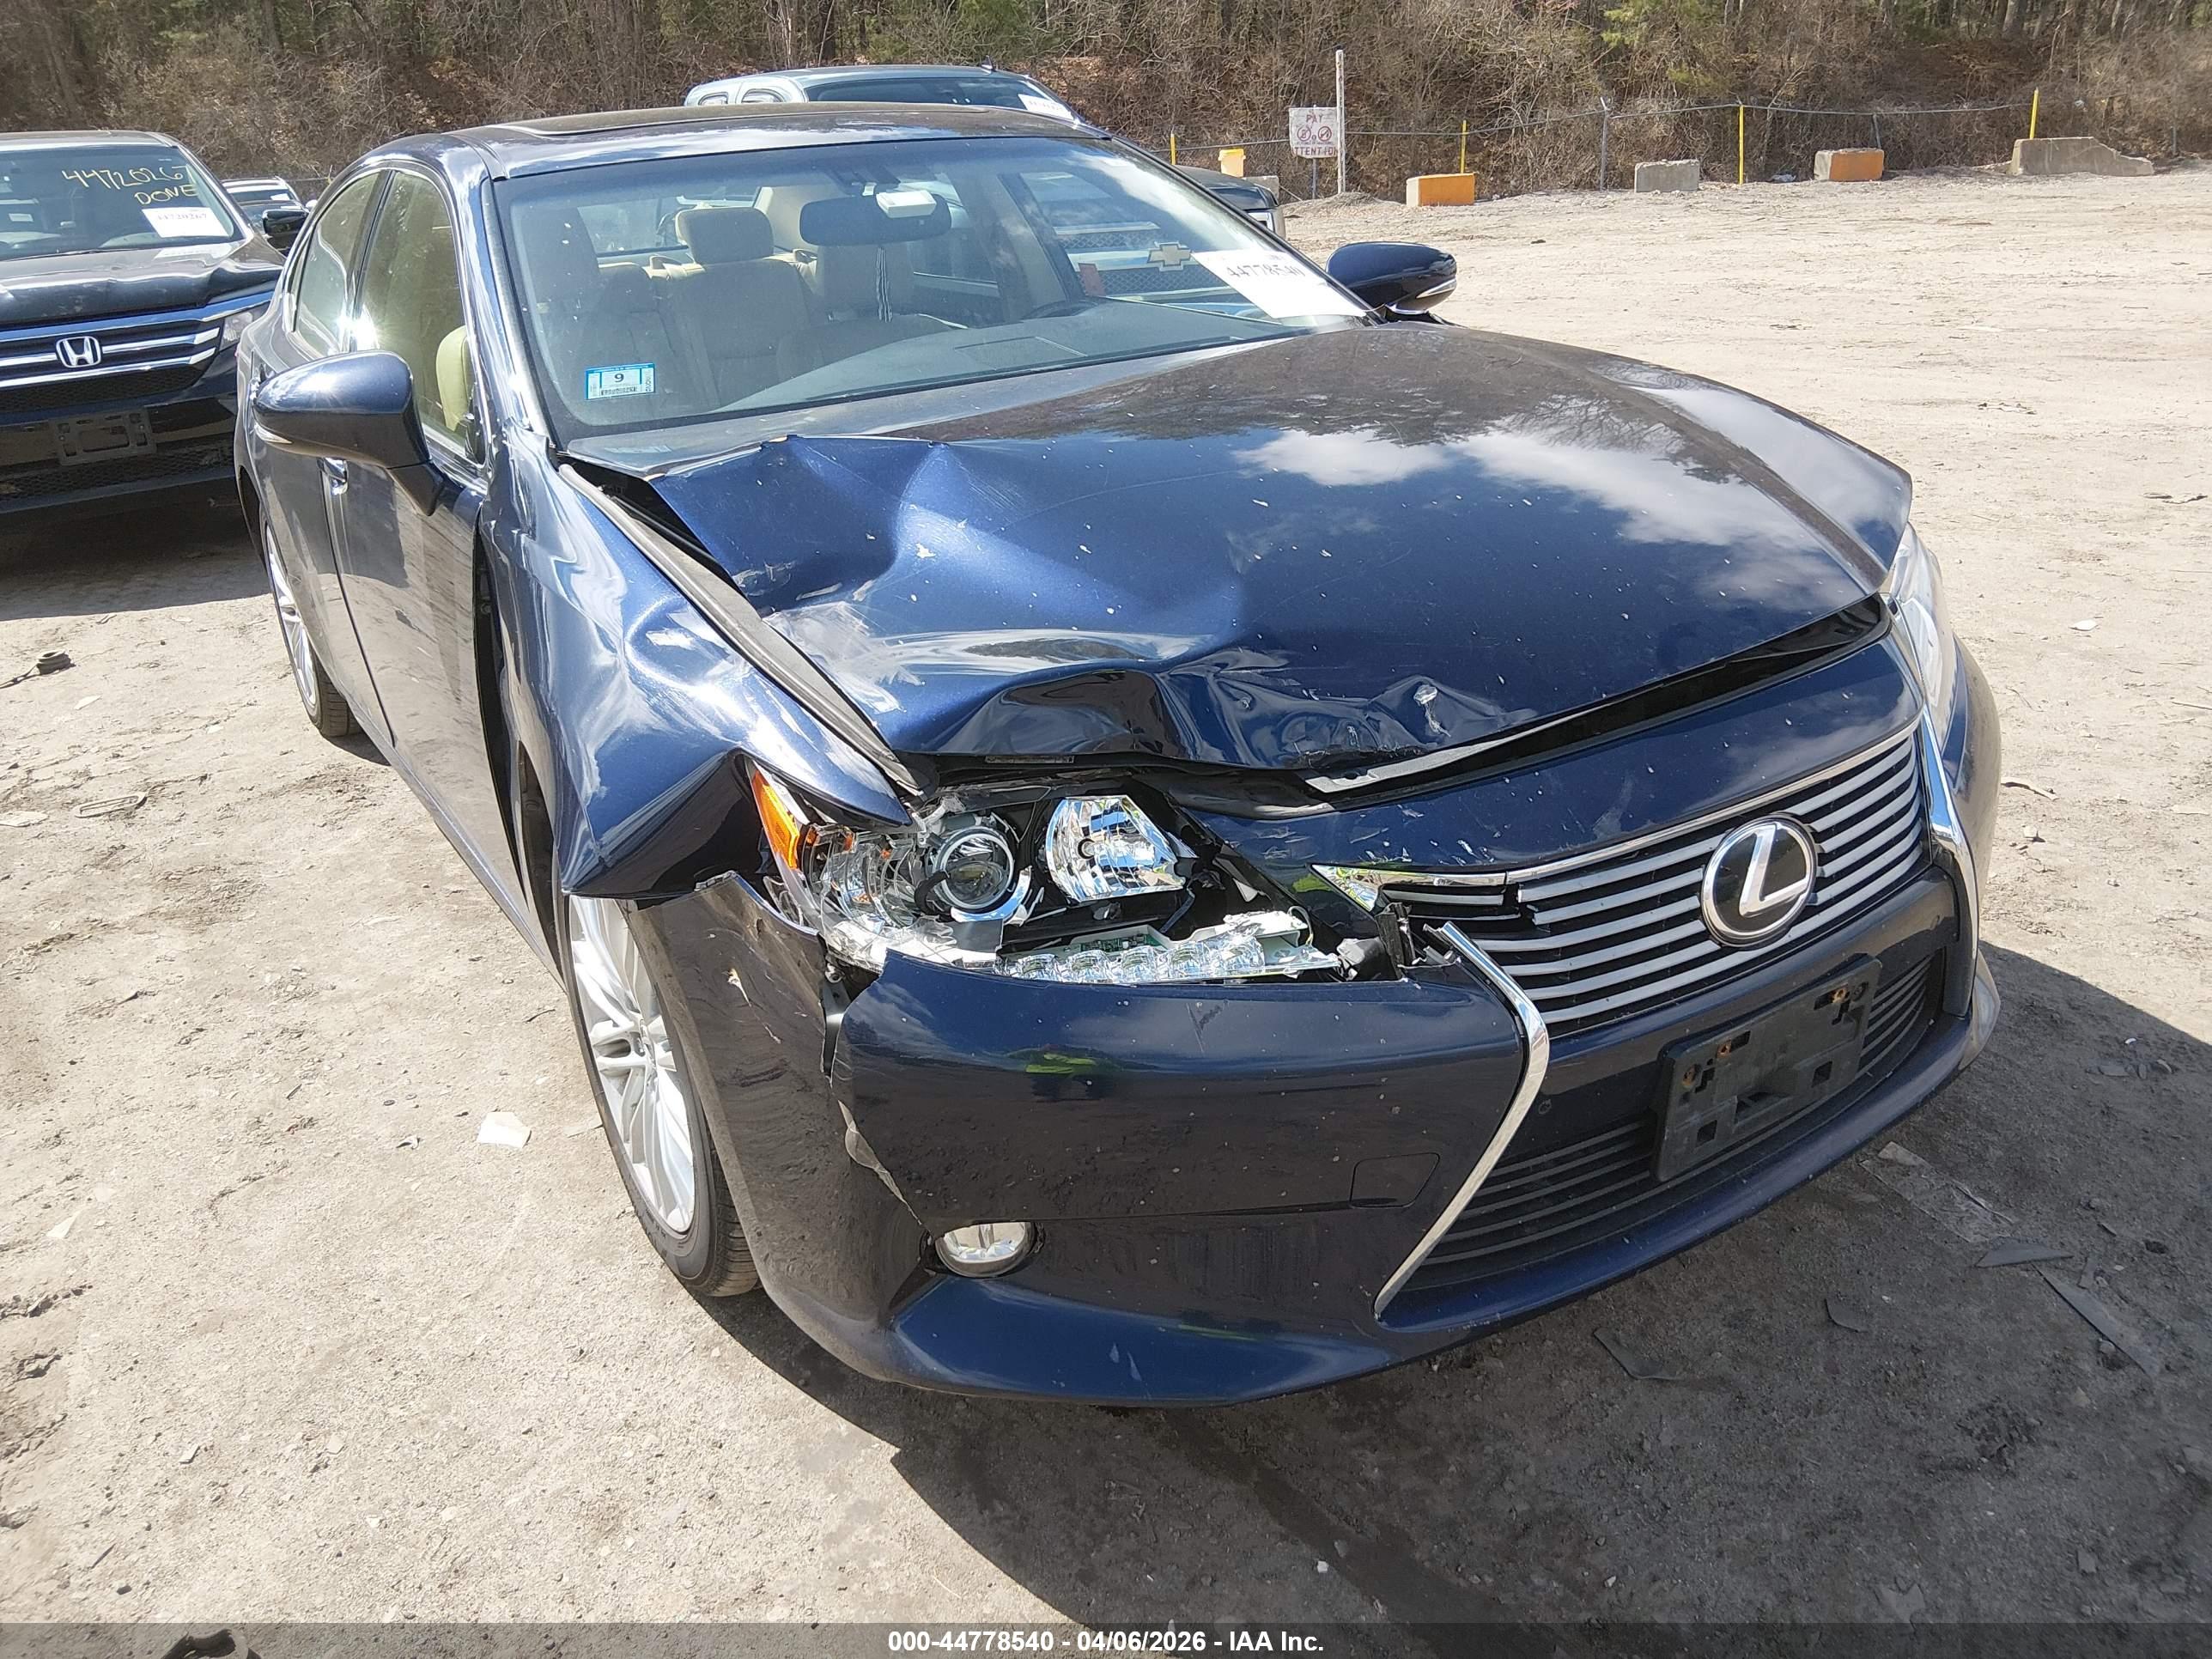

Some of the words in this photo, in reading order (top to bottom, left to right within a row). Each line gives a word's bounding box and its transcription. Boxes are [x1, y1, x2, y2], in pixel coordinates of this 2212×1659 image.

[1305, 114, 1323, 123] PAY
[134, 184, 198, 205] DONE
[614, 373, 624, 383] 9
